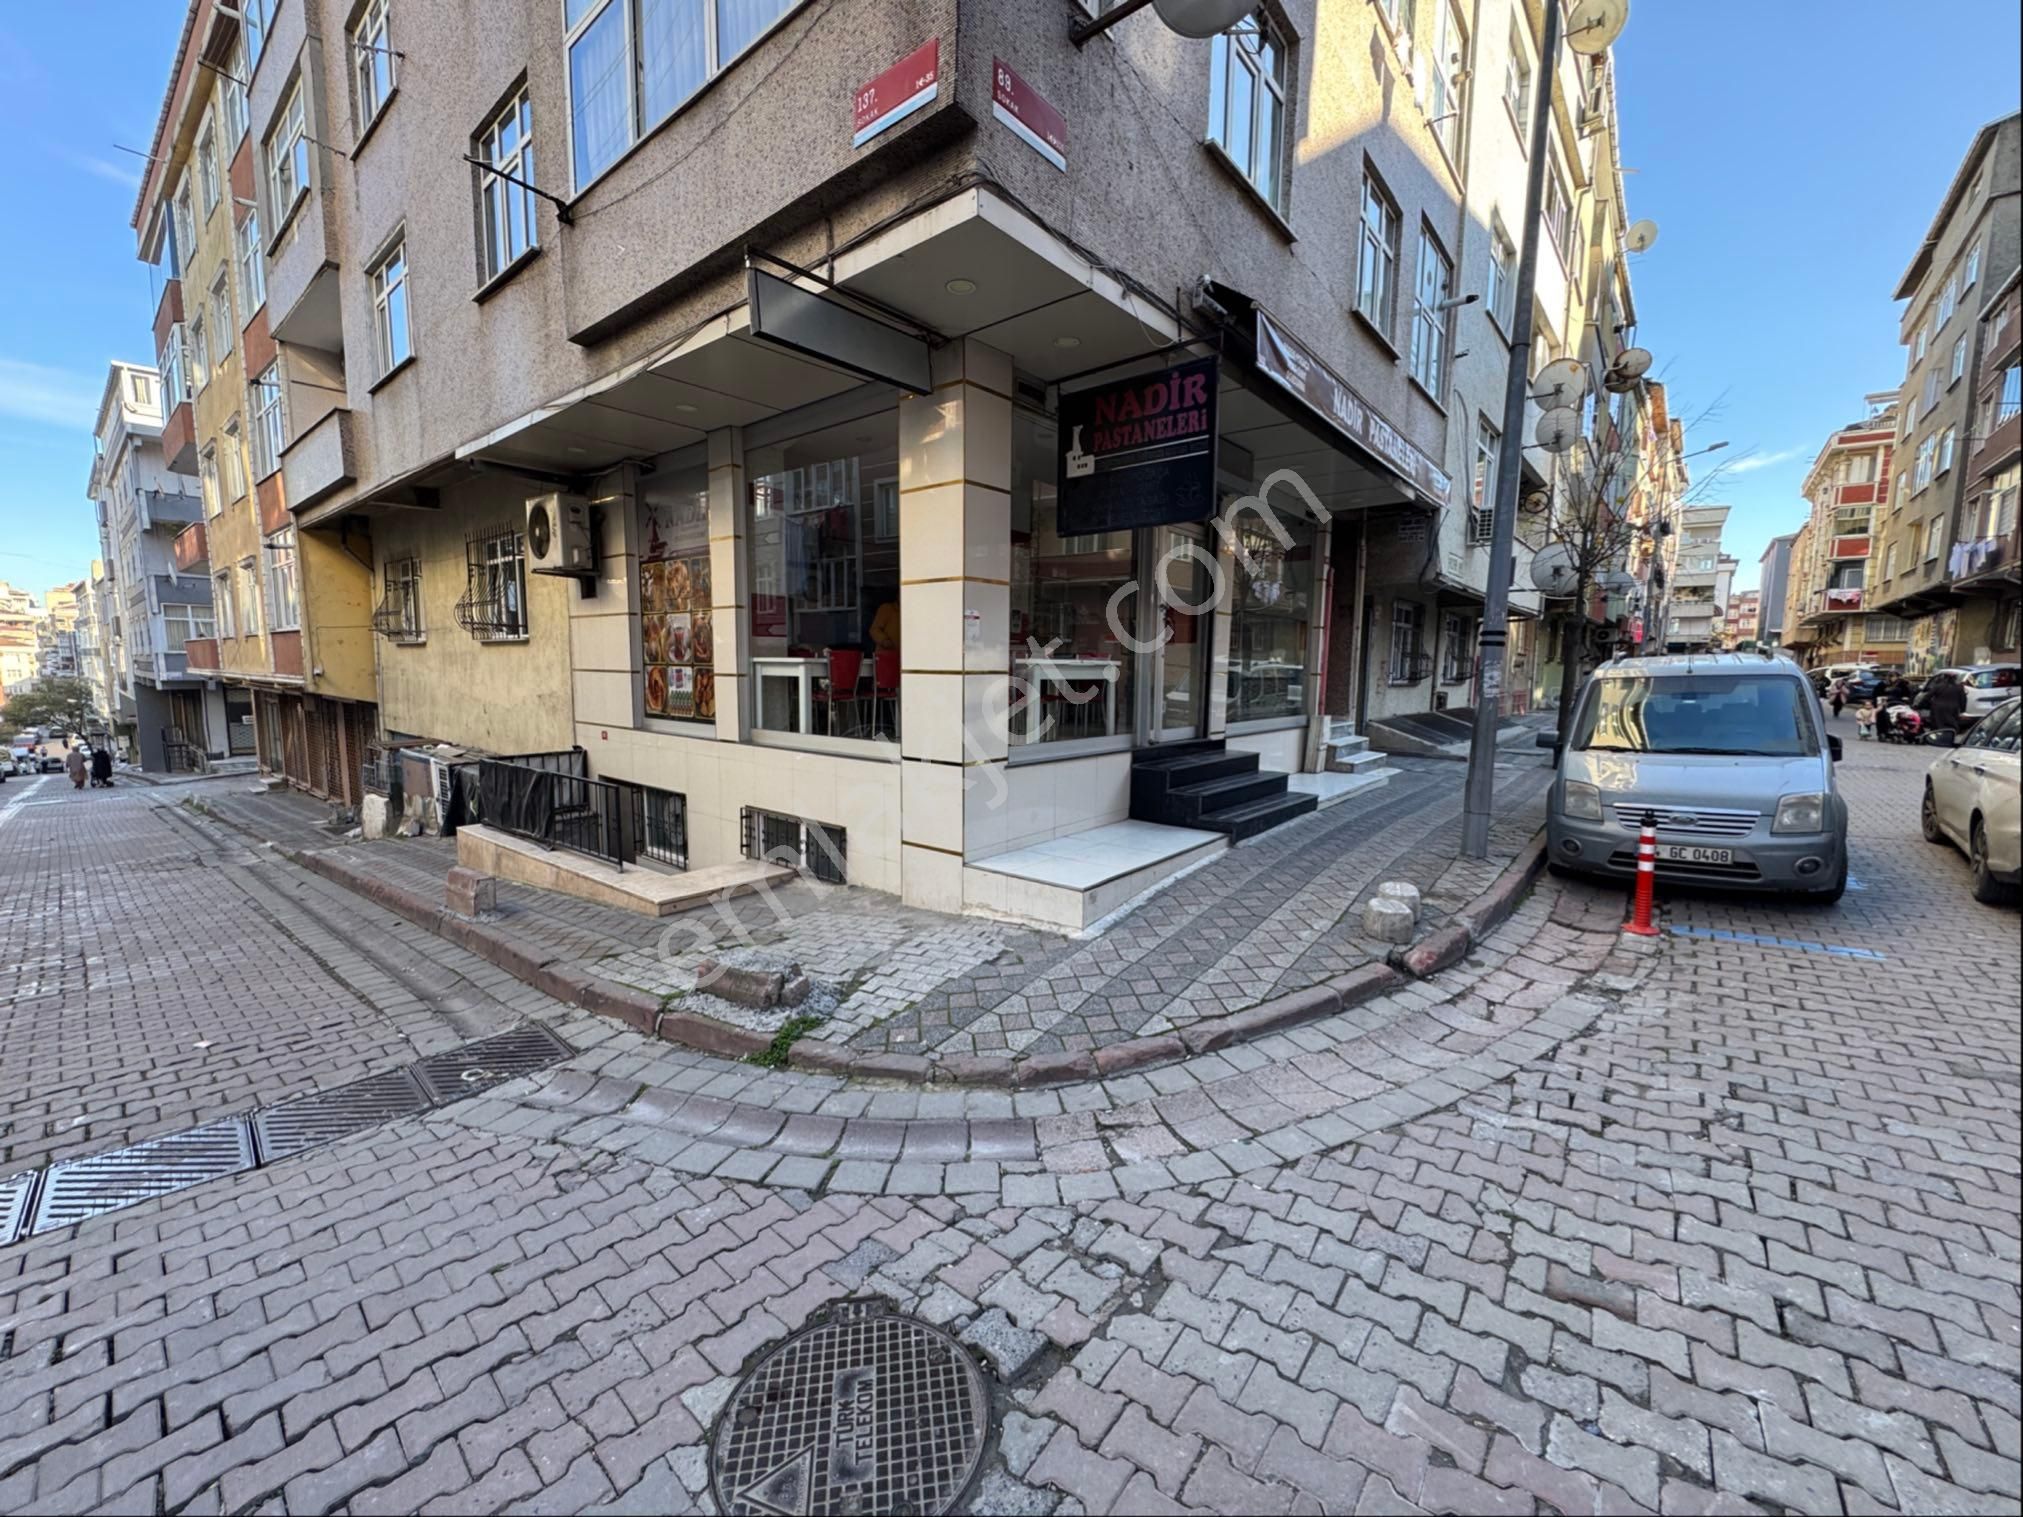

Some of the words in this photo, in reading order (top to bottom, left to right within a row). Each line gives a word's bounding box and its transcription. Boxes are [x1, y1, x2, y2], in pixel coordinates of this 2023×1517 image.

[997, 68, 1015, 96] 88.
[1093, 371, 1209, 426] NADİR
[1670, 847, 1688, 860] GC
[1693, 849, 1729, 862] 0408
[834, 1399, 855, 1448] TÜRK
[854, 1377, 875, 1466] TELEKOM
